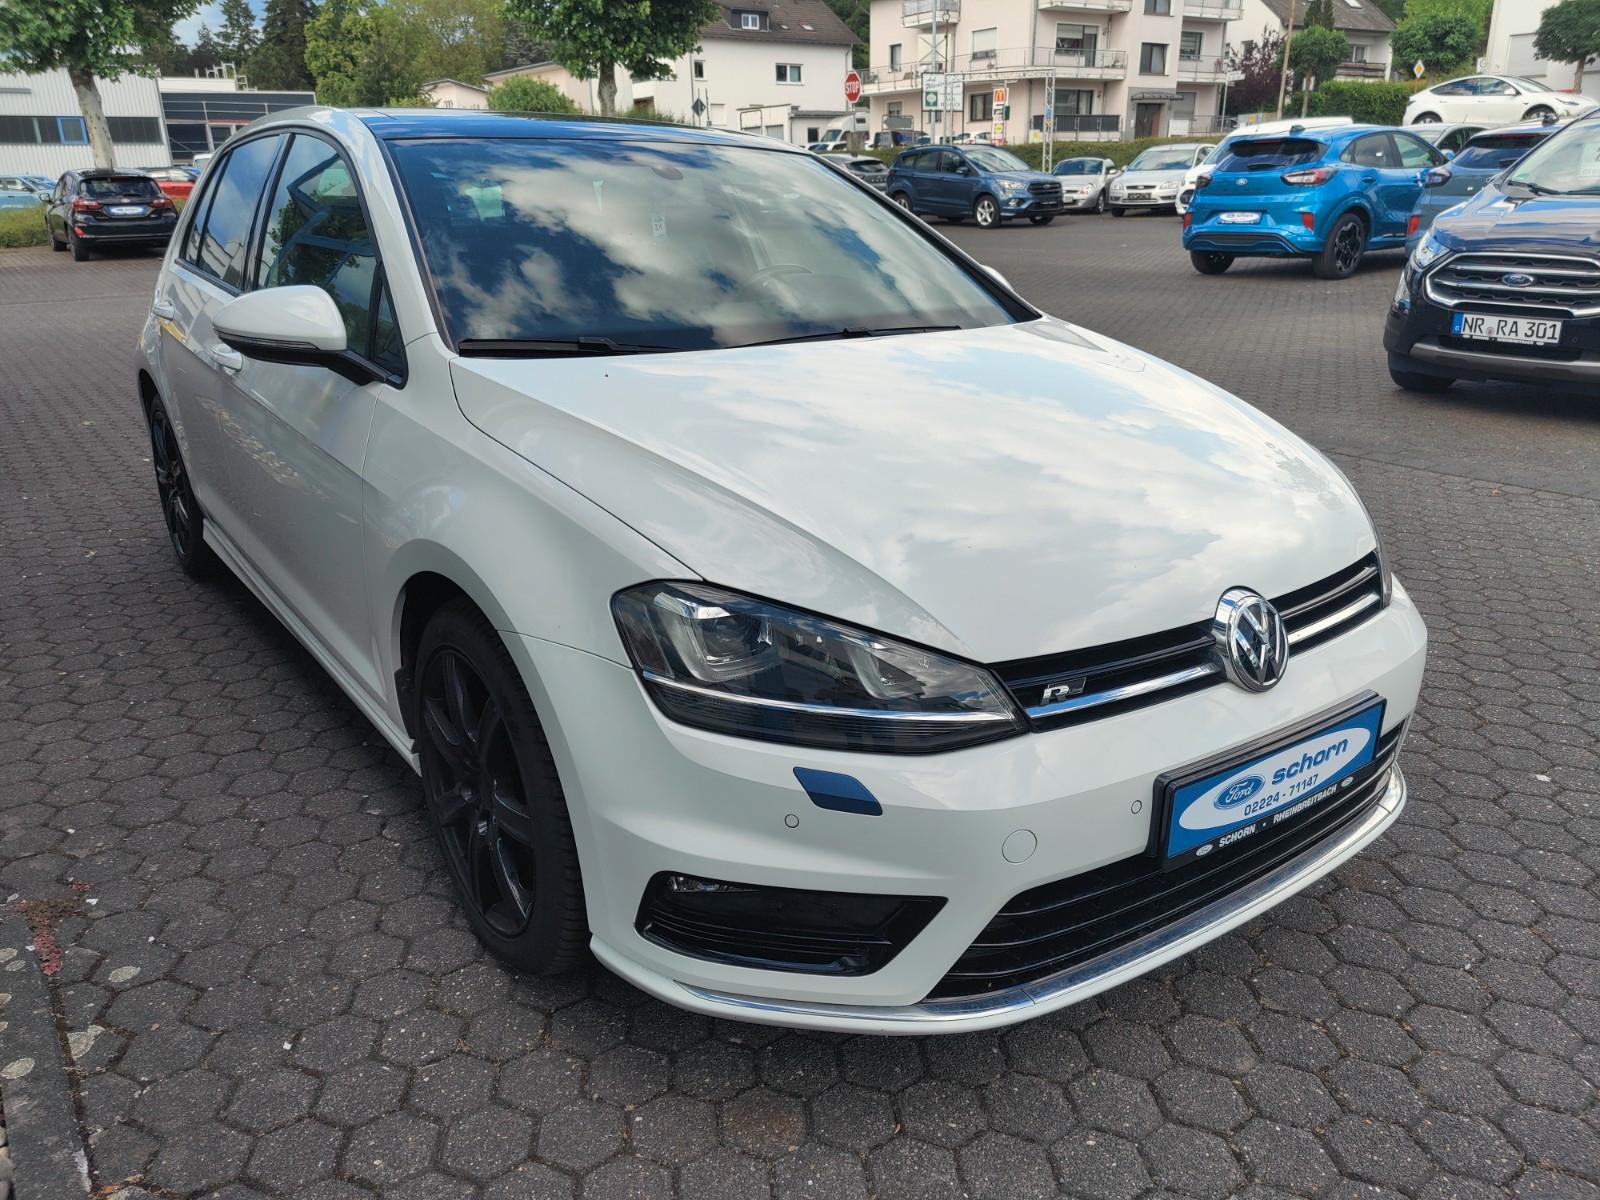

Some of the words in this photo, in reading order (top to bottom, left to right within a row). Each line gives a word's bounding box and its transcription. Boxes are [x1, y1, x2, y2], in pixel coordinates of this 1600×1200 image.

[846, 81, 860, 94] STOP
[1462, 317, 1485, 334] NR
[1496, 319, 1518, 337] RA
[1524, 321, 1558, 340] 301
[1225, 780, 1256, 803] Ford
[1271, 738, 1349, 785] schorn
[1218, 823, 1257, 848] SCHORN
[1273, 783, 1338, 824] RHEINBREITBACH
[1244, 791, 1280, 816] 02224
[1289, 773, 1319, 796] 71147
